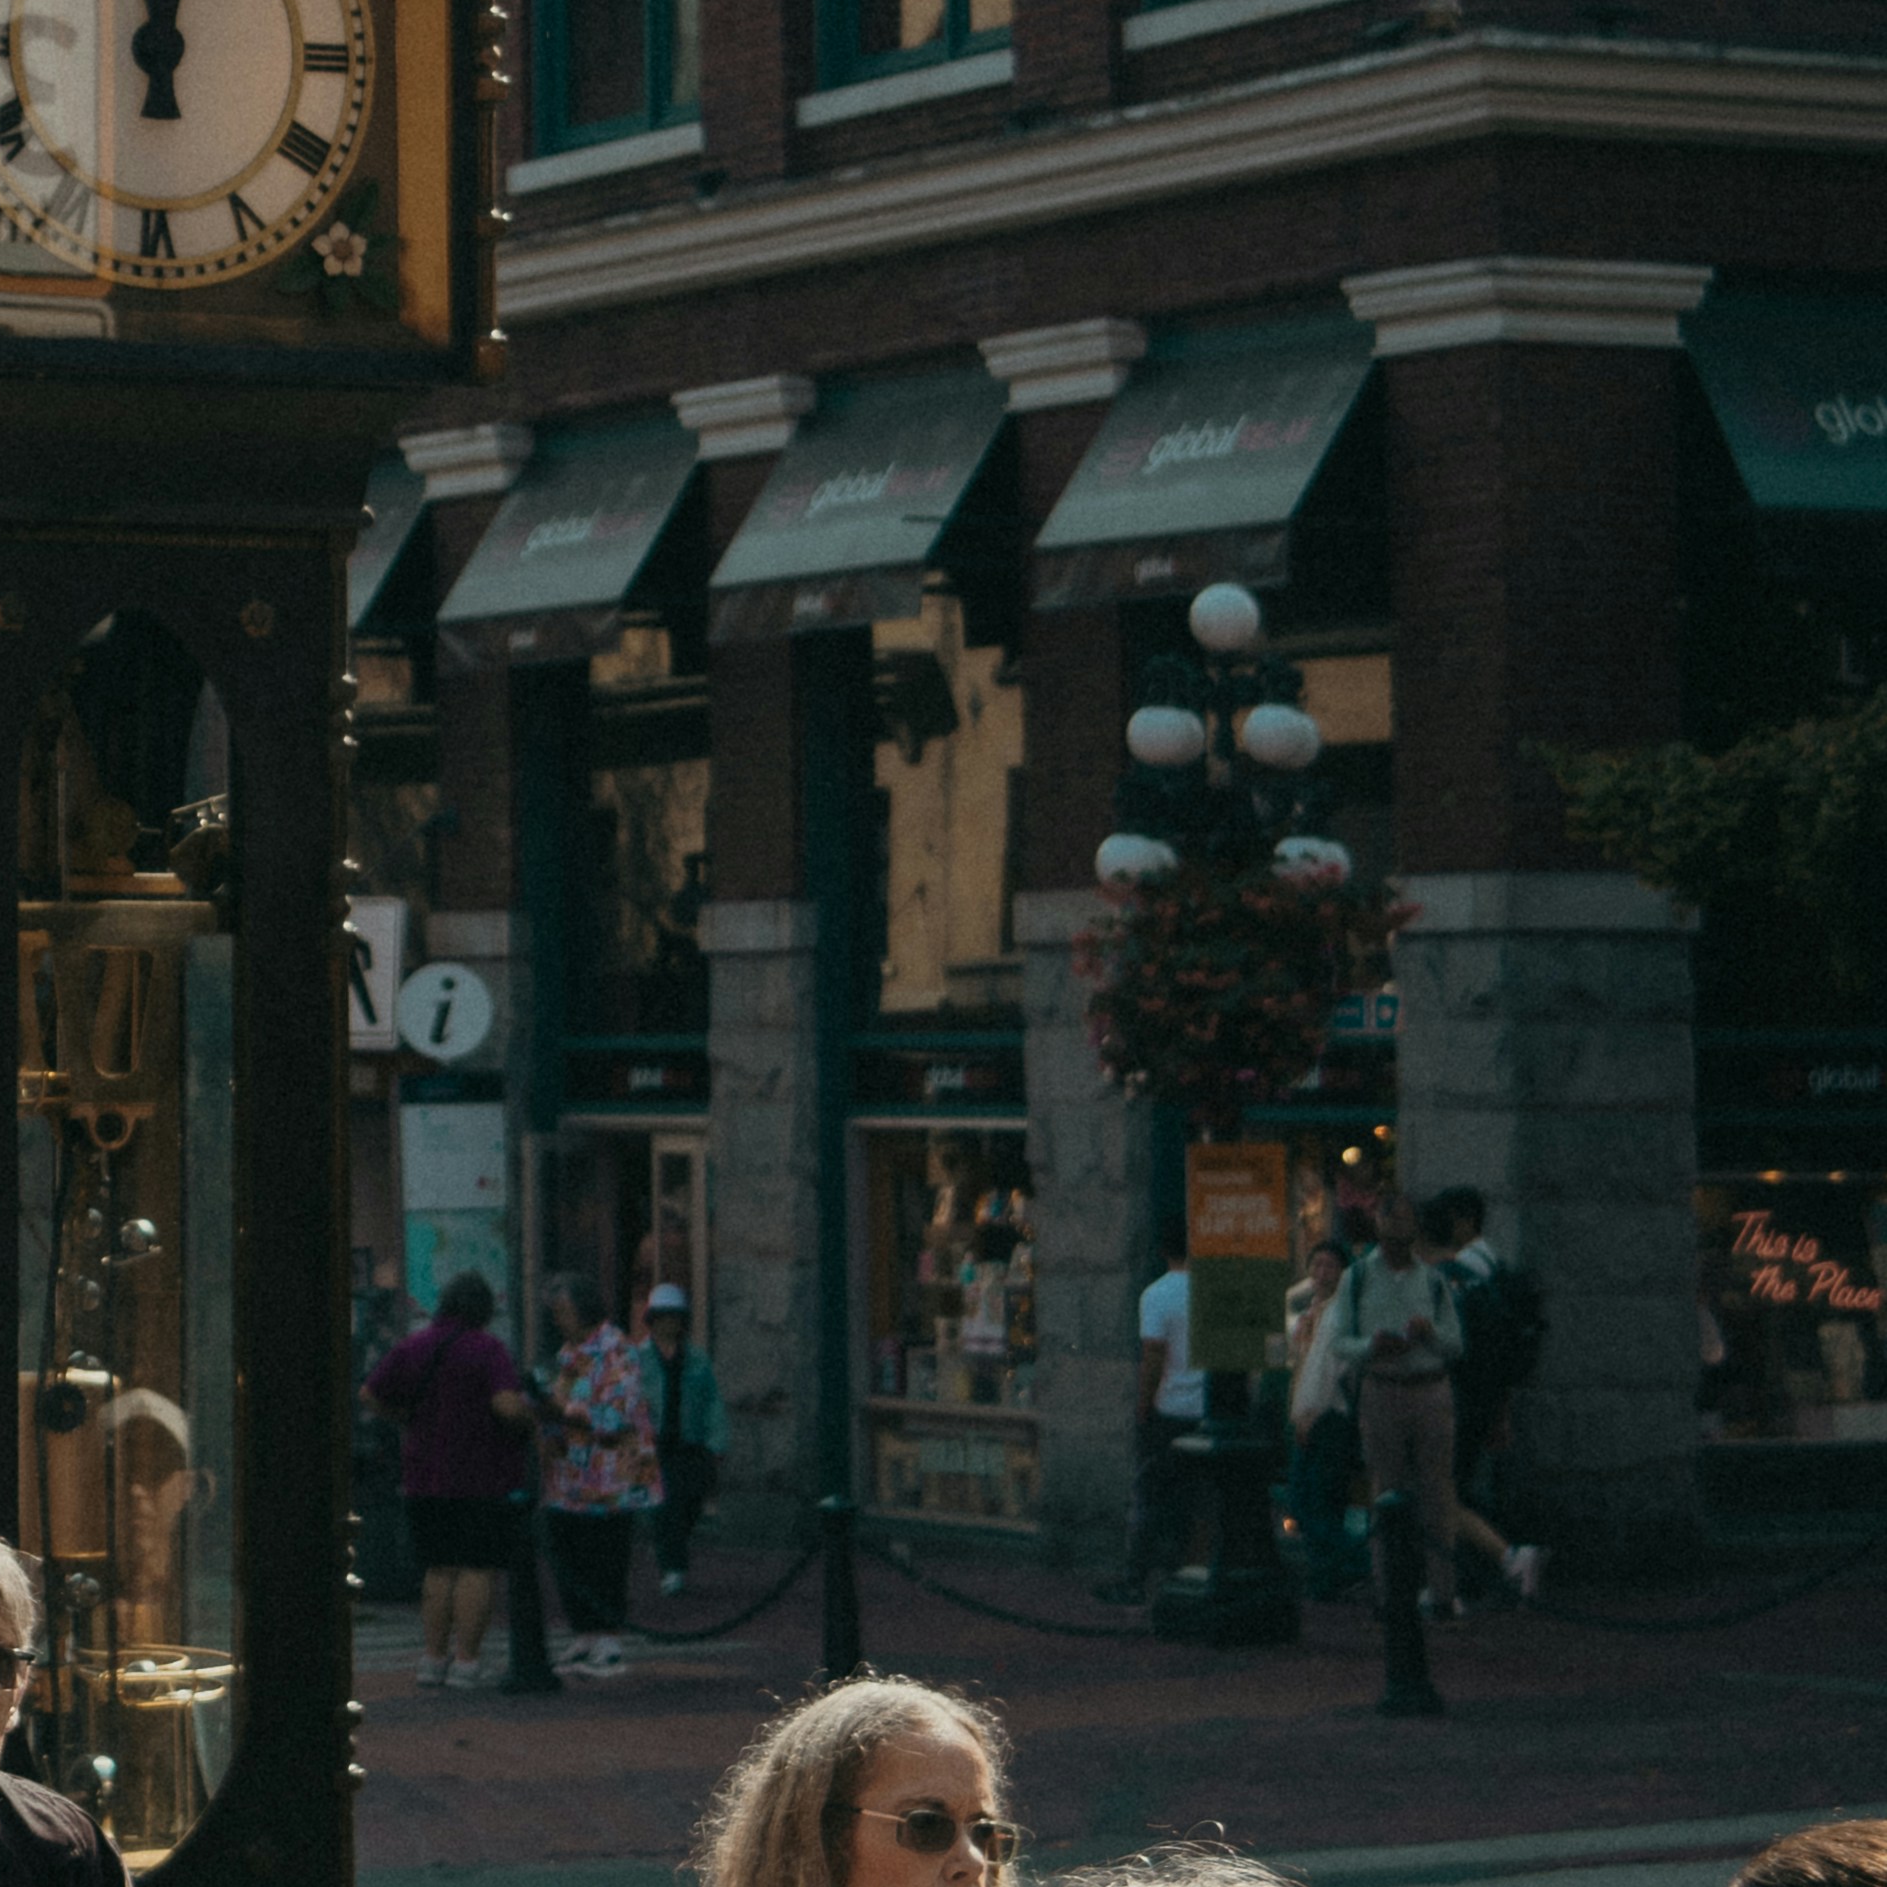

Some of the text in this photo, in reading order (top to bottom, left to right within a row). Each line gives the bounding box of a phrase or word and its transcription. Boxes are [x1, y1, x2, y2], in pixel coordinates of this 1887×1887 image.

[302, 43, 350, 73] III
[141, 208, 176, 260] VI
[1146, 415, 1246, 474] global
[1731, 1209, 1820, 1264] This is
[1749, 1259, 1882, 1311] the Place
